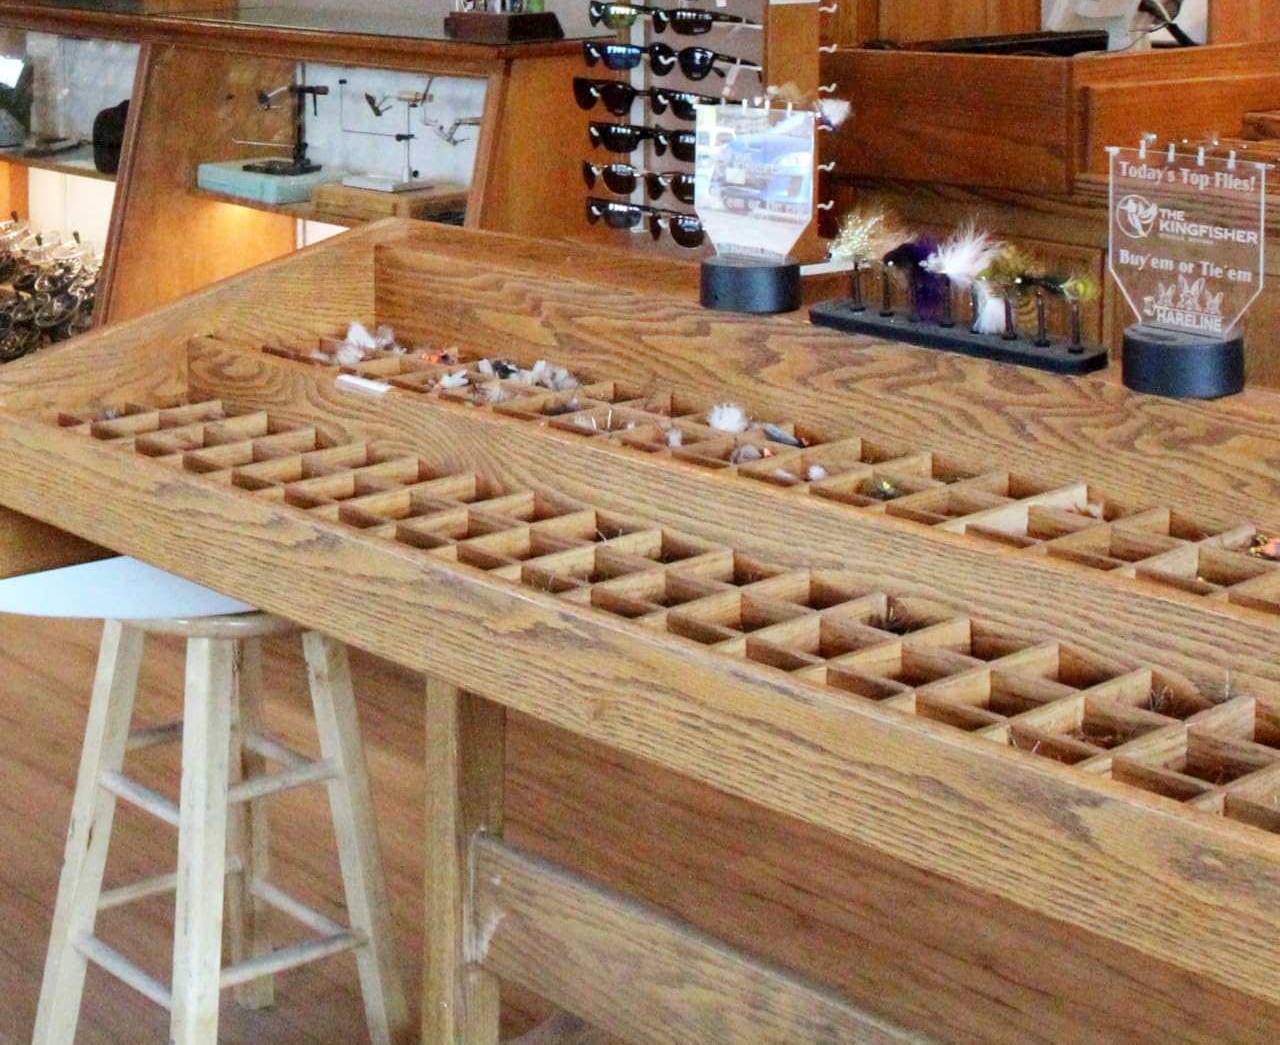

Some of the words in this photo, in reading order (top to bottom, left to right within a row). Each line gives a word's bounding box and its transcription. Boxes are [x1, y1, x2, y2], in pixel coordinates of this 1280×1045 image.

[1119, 161, 1176, 185] Today's
[1180, 168, 1209, 191] Top
[1215, 171, 1256, 192] Flies!
[1159, 208, 1185, 221] THE
[1159, 220, 1258, 244] KINGFISHER
[1179, 261, 1194, 273] or
[1156, 308, 1224, 332] HARELINE
